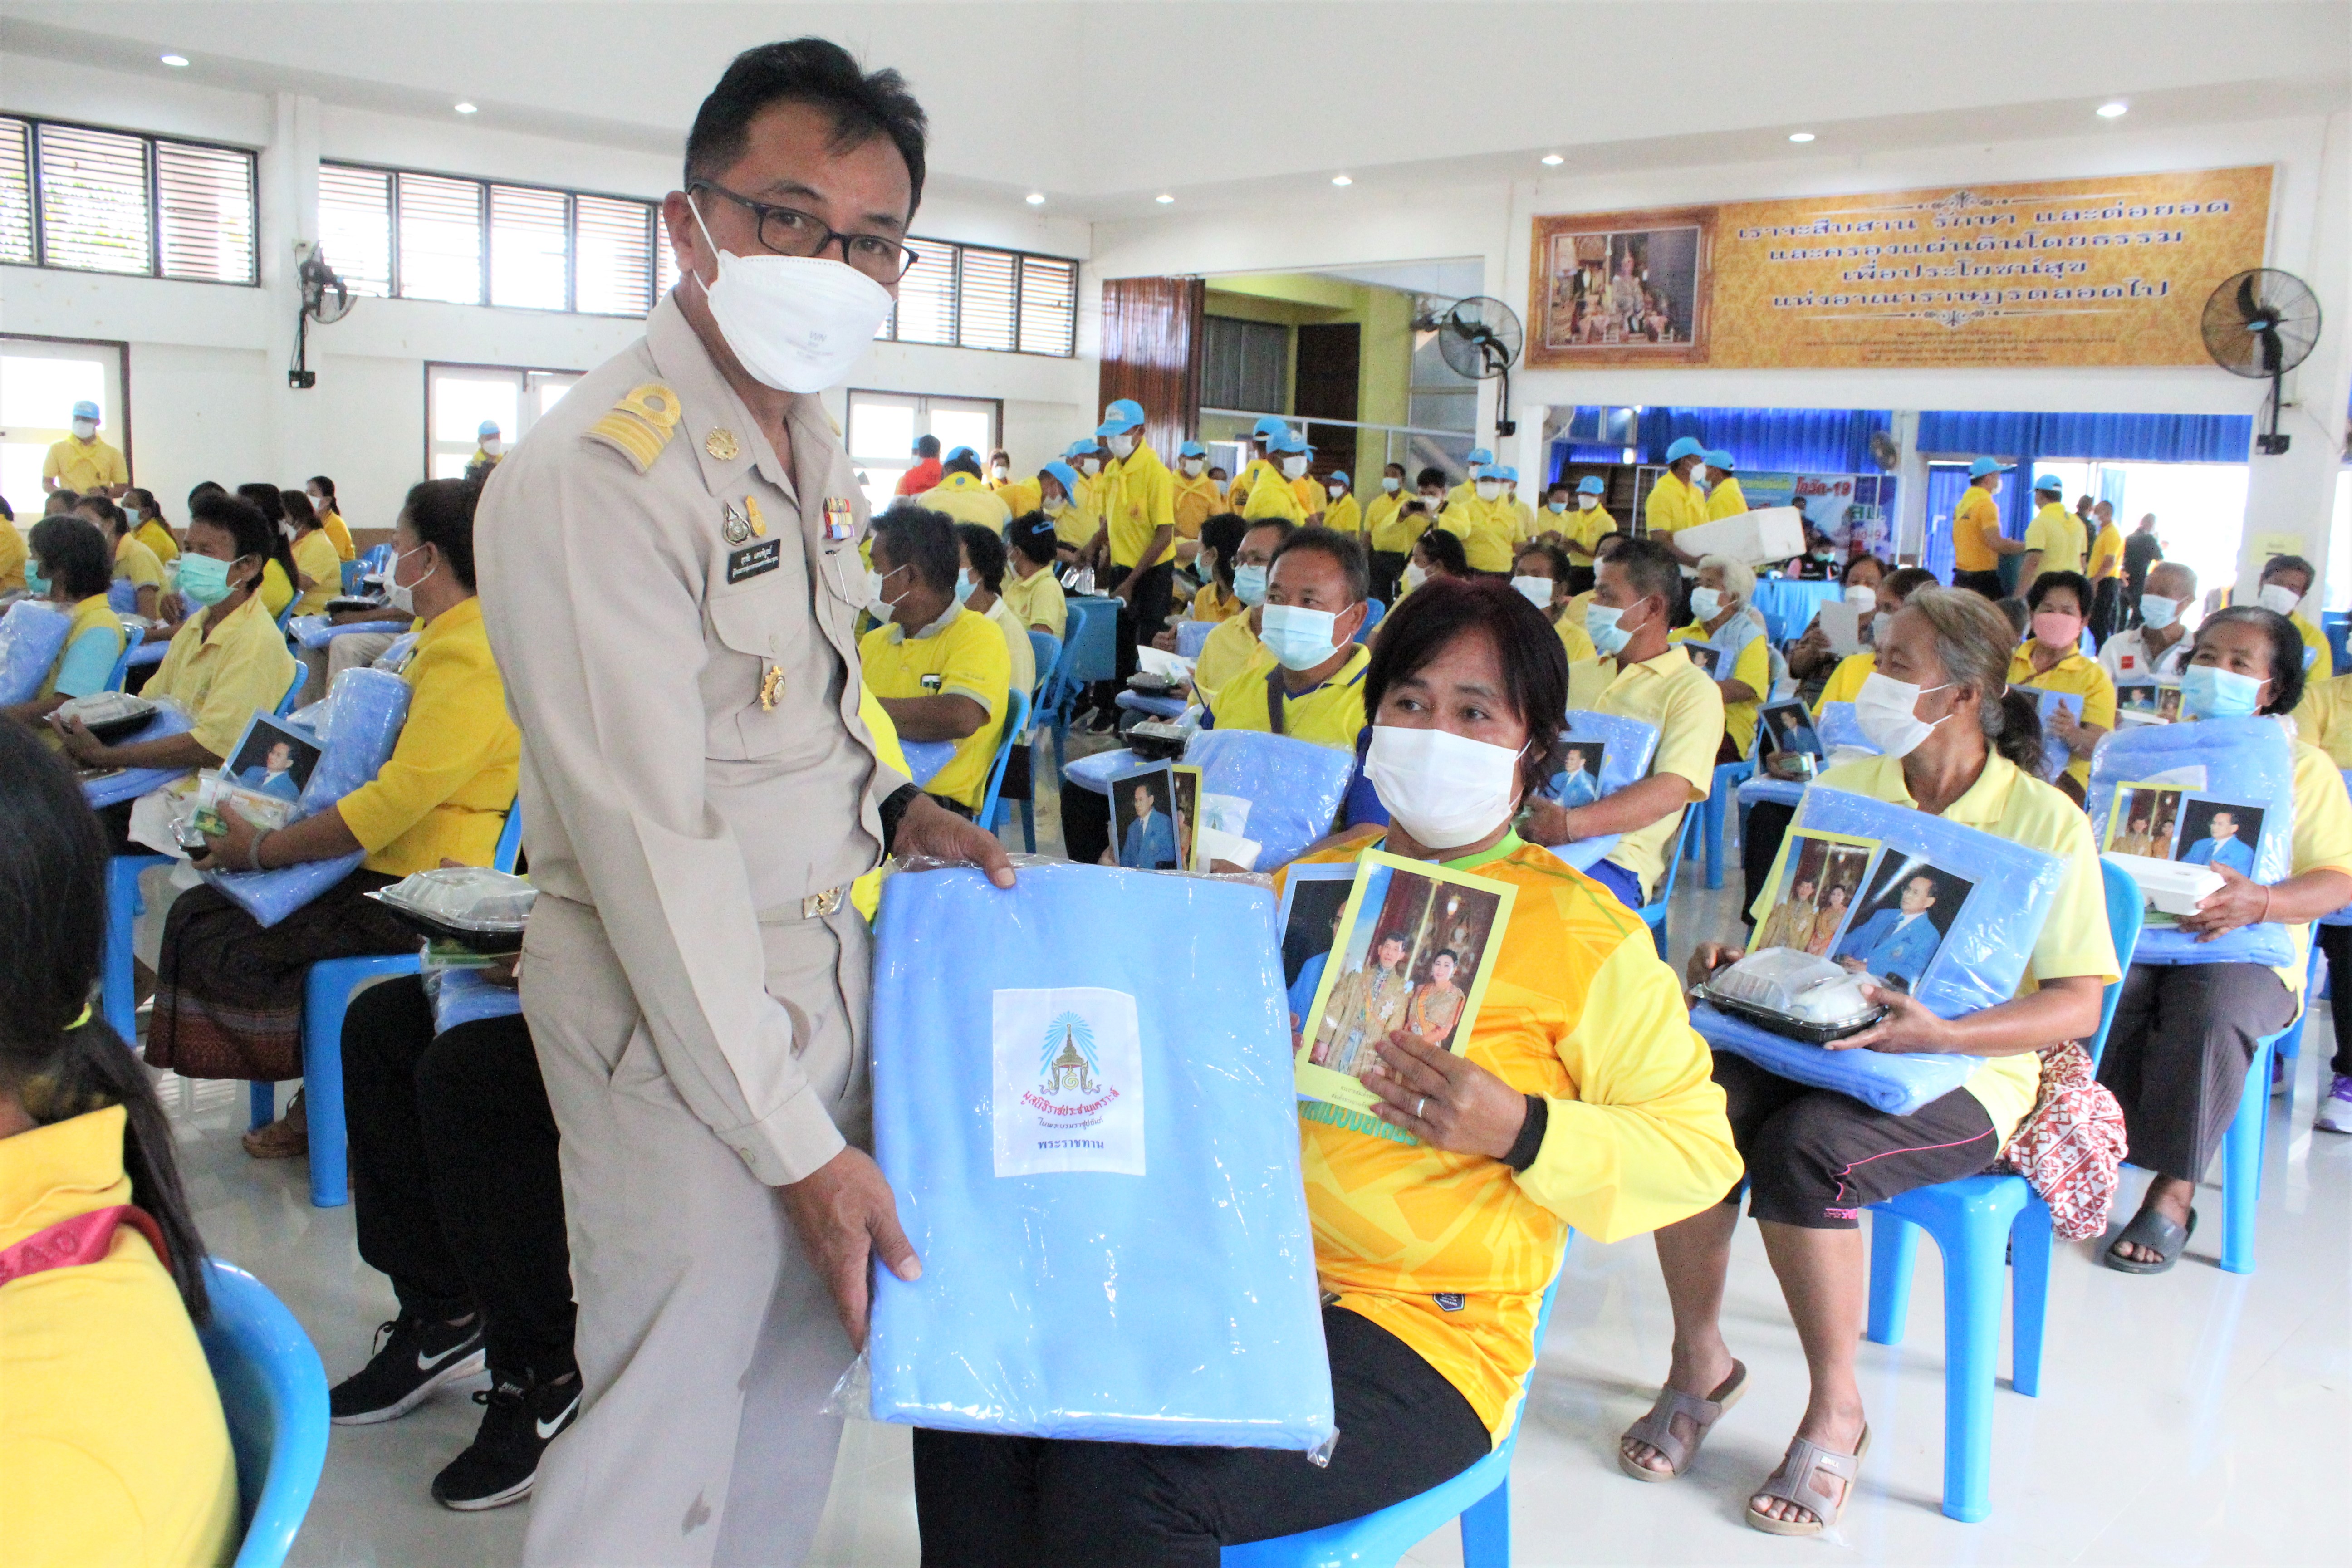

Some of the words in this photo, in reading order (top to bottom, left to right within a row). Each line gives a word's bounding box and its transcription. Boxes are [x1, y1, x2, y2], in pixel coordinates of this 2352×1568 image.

[1740, 218, 1916, 238] เราจะสืบสาน
[1934, 212, 2015, 227] รักษา
[2036, 201, 2230, 223] และต่อยอด
[1770, 230, 2182, 260] และครองแผ่นดินโดยธรรม
[1843, 257, 2086, 282] เพื่อประโยชน์สุข
[1774, 278, 2168, 306] แห่งอาณาราษฎรตลอดไป
[1020, 1085, 1120, 1116] มูลนิธิราชประชานุเคราะห์
[1038, 1138, 1104, 1150] พระราชทาน
